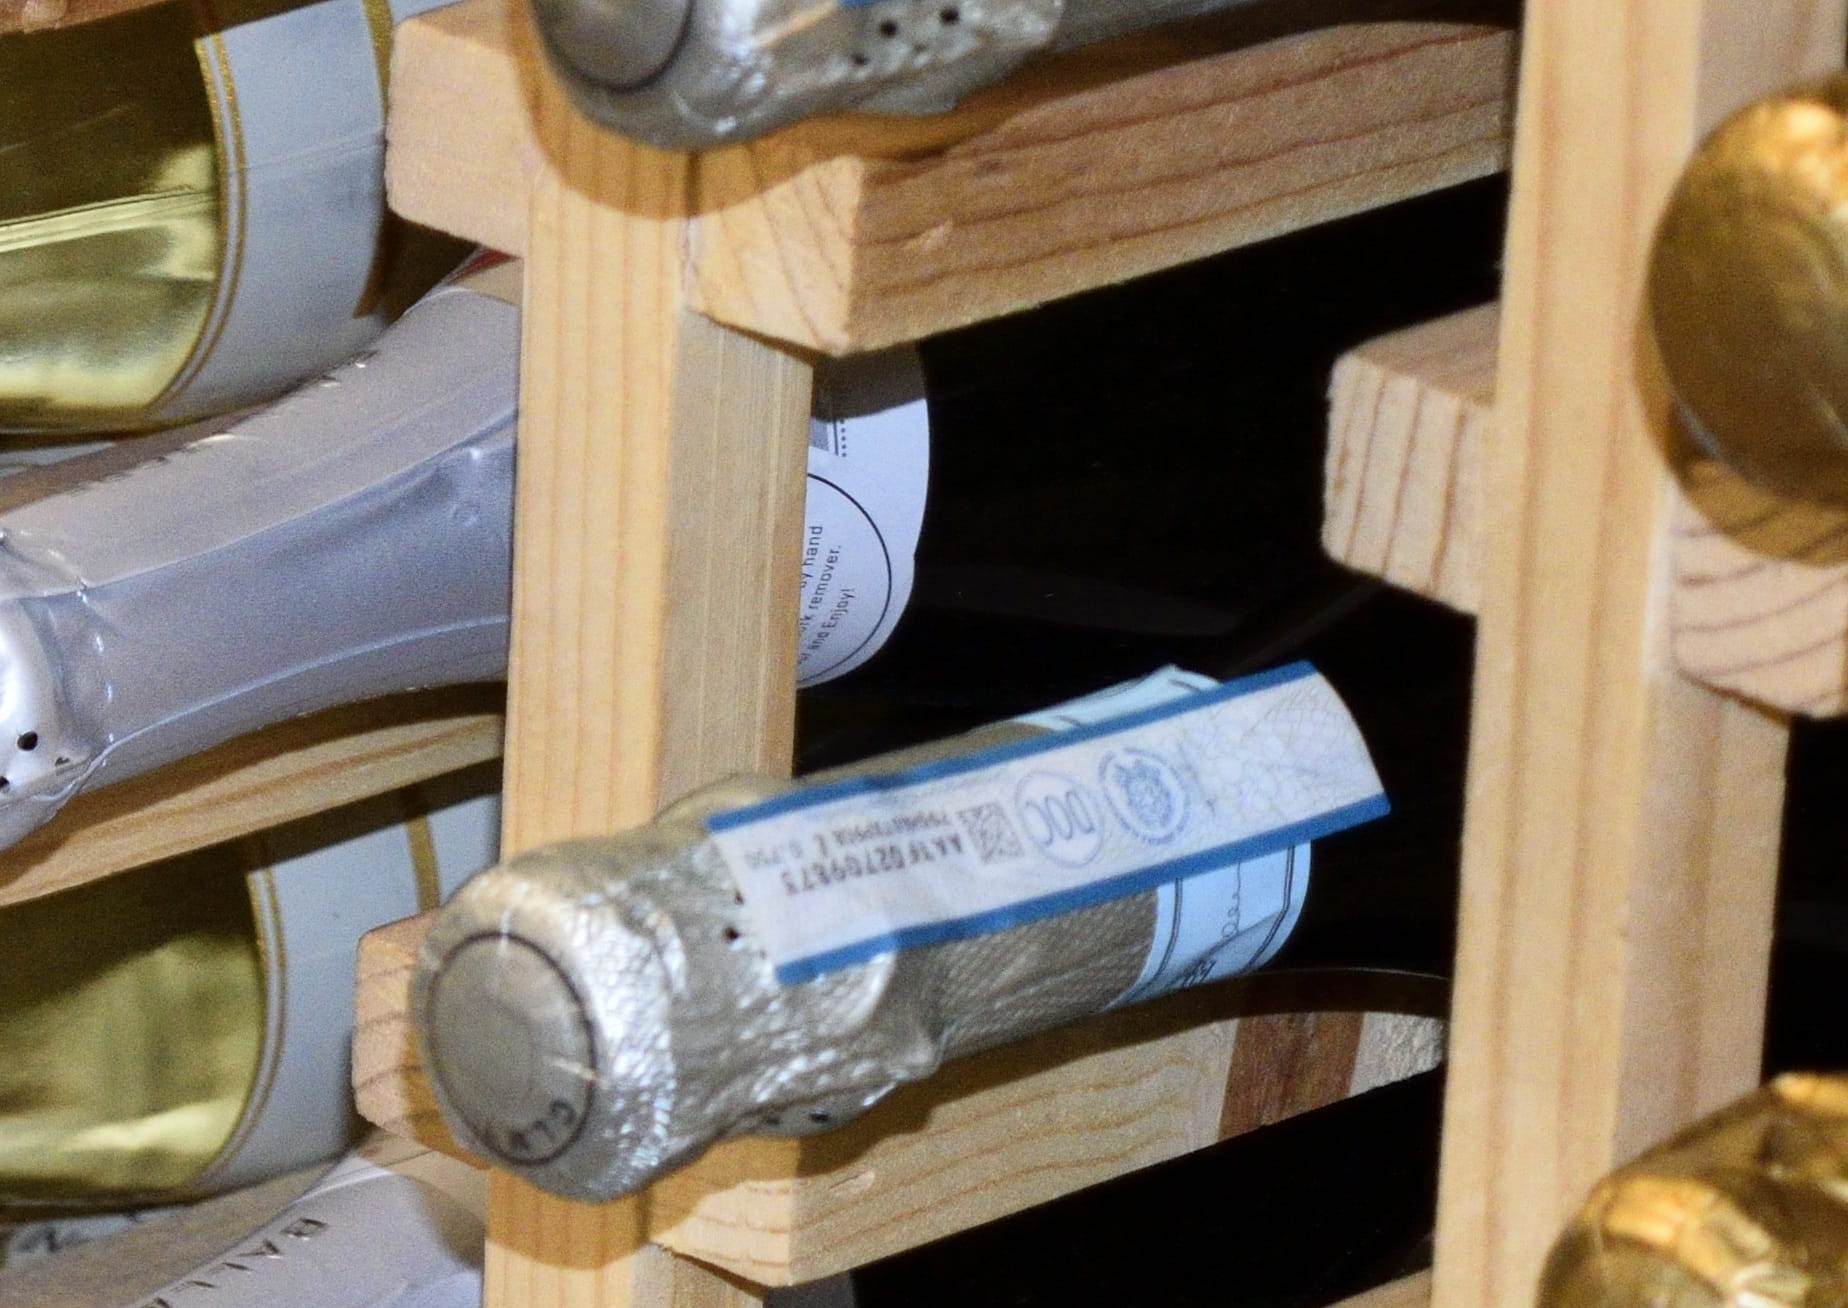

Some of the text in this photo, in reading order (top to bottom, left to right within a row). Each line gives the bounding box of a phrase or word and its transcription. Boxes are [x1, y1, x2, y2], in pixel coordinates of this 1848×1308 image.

[804, 525, 823, 567] hand
[809, 544, 842, 611] remover.
[824, 586, 856, 631] Enjoy!
[1037, 789, 1096, 847] DOC
